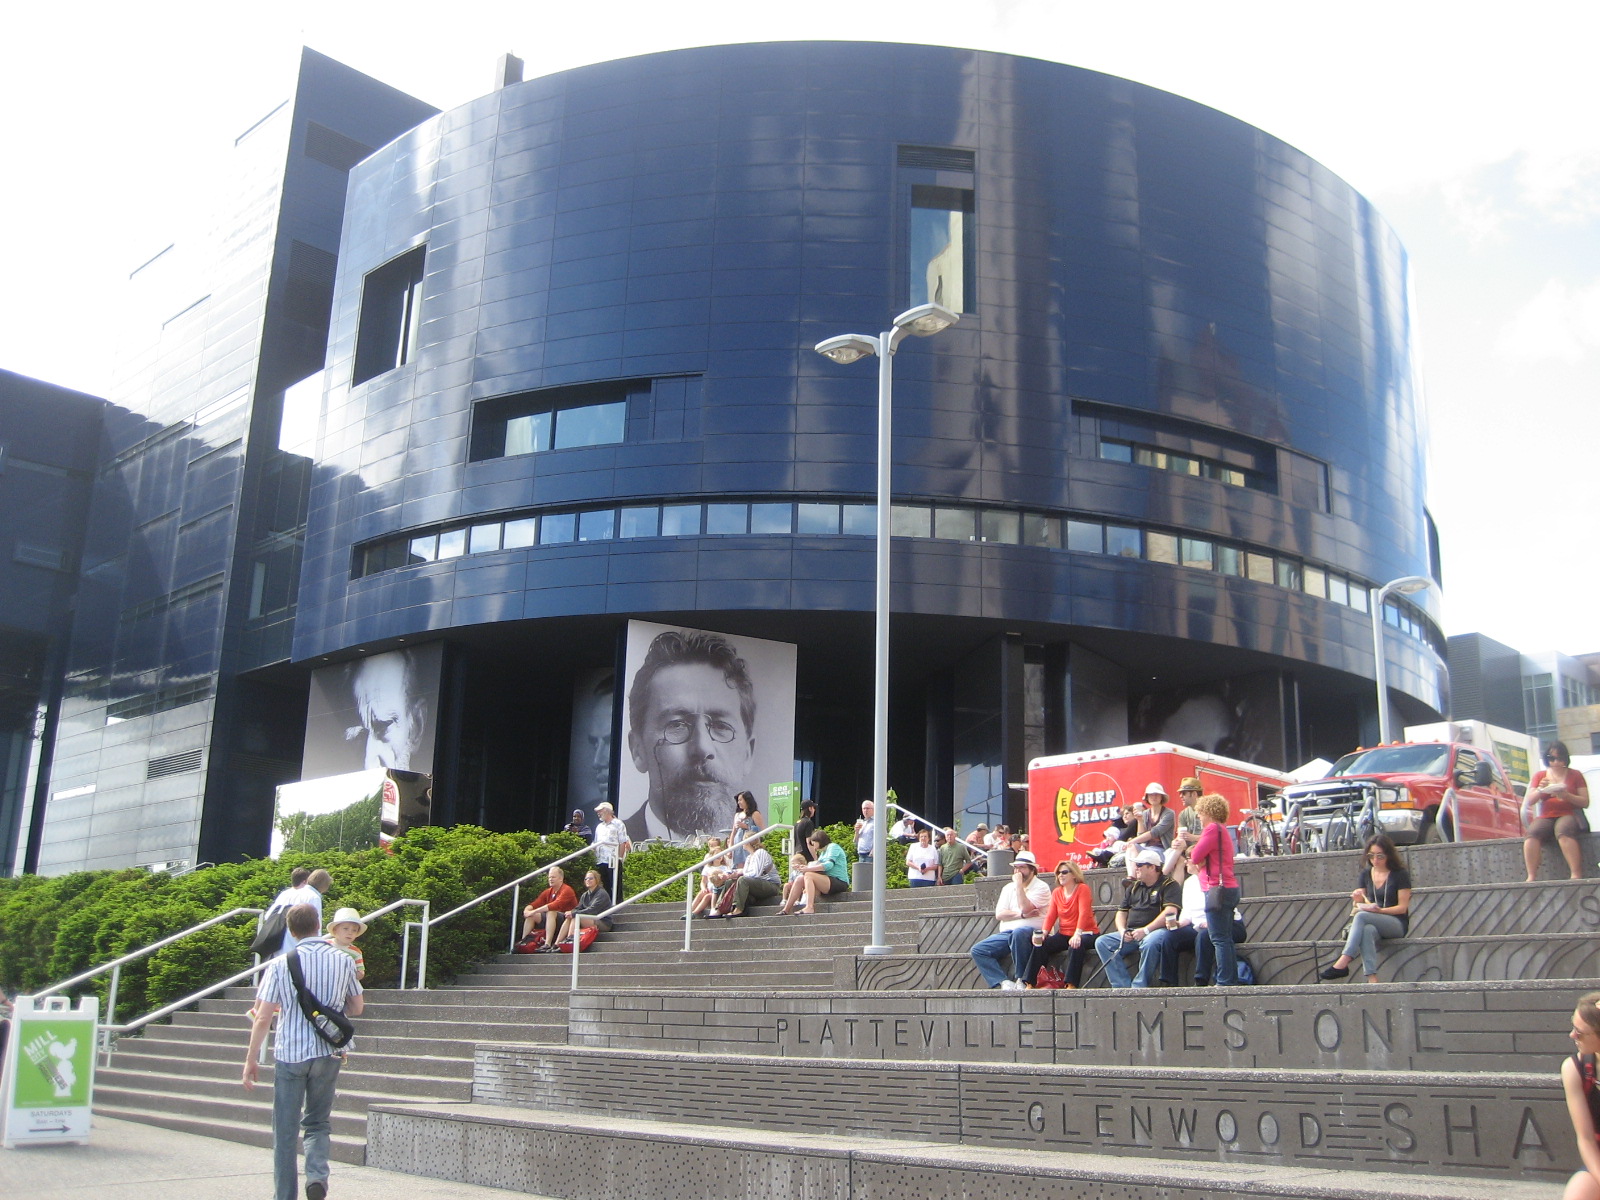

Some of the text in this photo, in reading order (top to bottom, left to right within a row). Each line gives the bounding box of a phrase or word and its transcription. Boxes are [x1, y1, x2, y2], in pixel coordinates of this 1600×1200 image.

[1075, 790, 1116, 807] CHEF
[1060, 797, 1069, 831] EAT
[1070, 806, 1120, 824] SHACK
[24, 1030, 57, 1057] MILL
[776, 1008, 1443, 1055] PLATTEVILLE LIMESTONE
[1027, 1101, 1322, 1149] GLENWOOD
